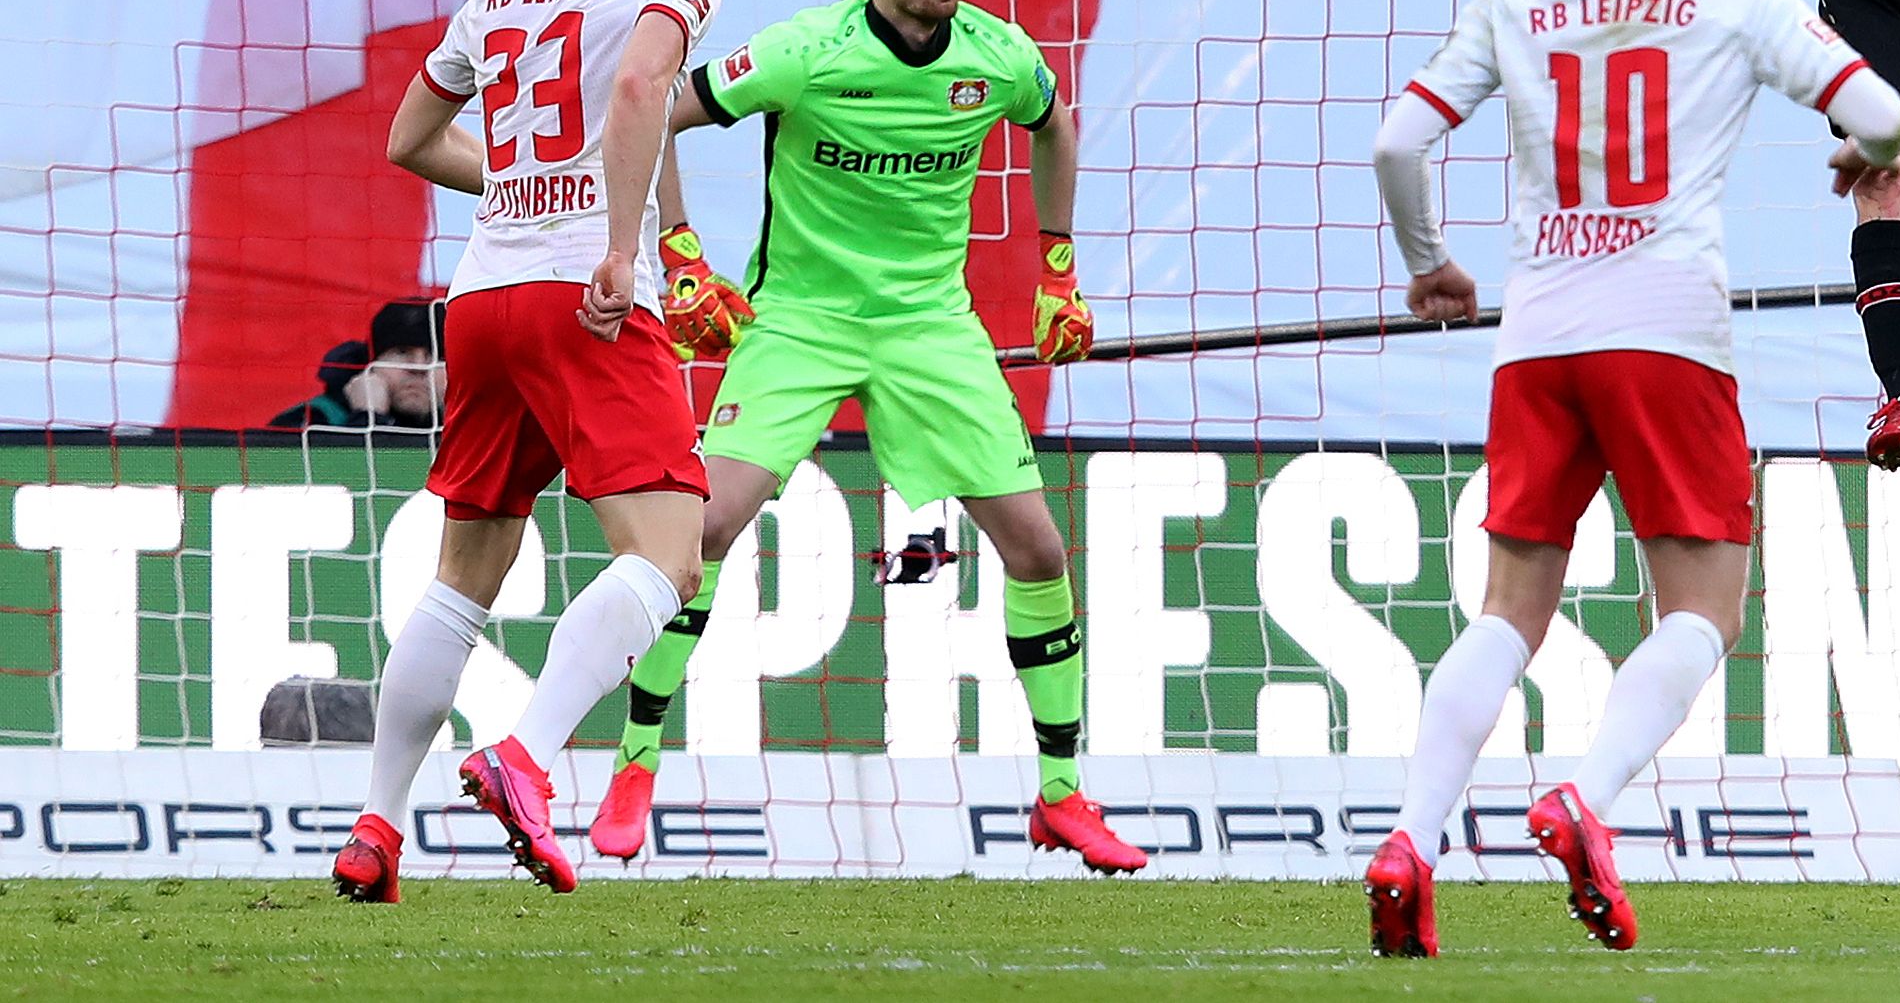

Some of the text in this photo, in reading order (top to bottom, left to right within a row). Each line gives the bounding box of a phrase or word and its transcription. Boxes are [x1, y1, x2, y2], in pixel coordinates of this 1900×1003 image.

[1529, 3, 1567, 34] RB
[482, 10, 585, 173] 23
[1547, 47, 1669, 210] 10
[1533, 213, 1656, 257] FORSBER
[0, 801, 769, 858] ORSCE
